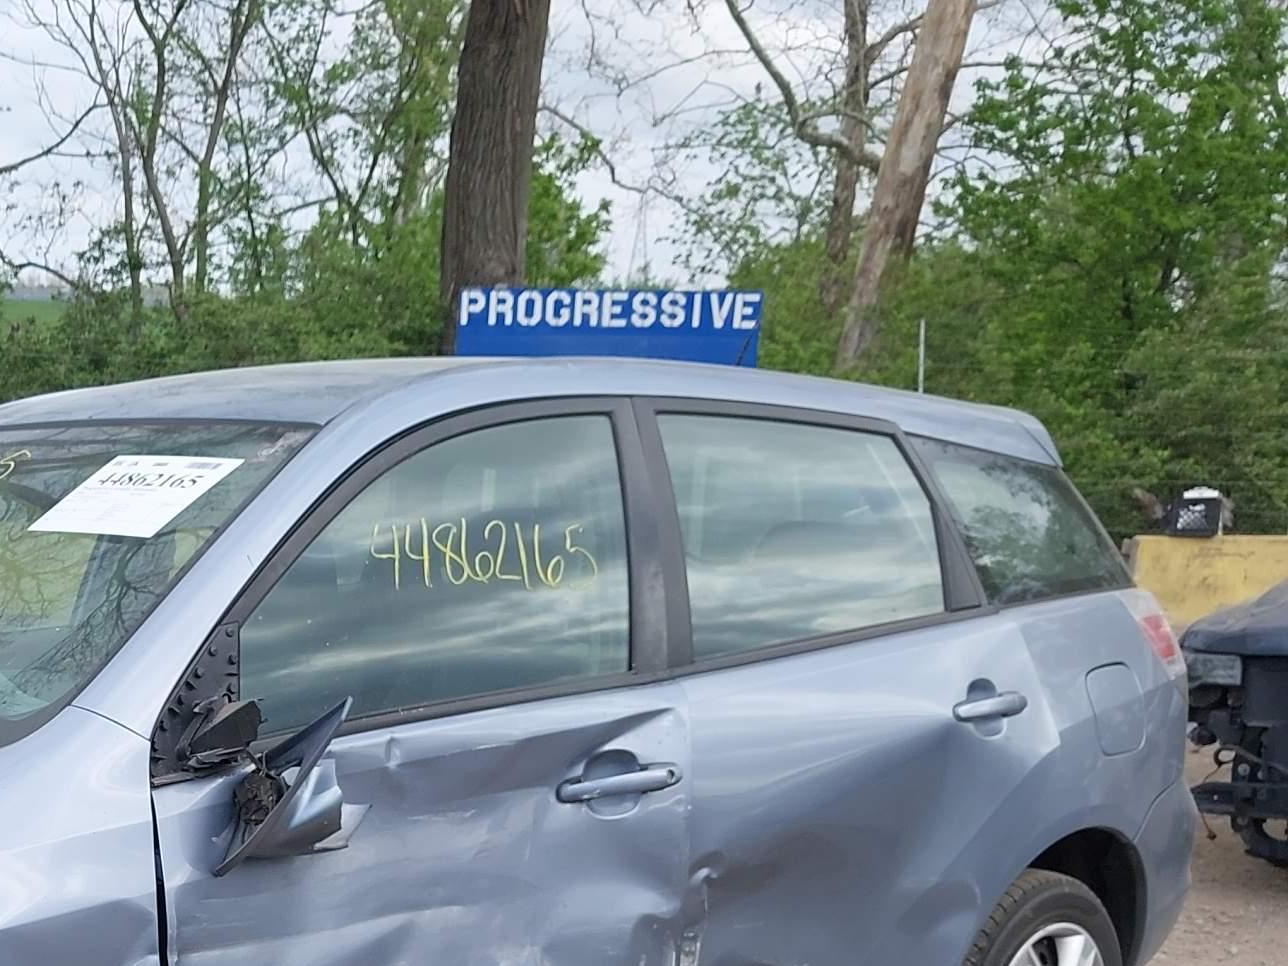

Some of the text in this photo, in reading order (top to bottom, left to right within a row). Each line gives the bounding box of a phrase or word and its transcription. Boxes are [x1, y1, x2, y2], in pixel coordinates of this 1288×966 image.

[459, 289, 761, 330] PROGRESSIVE
[97, 472, 205, 489] 44862165
[370, 517, 598, 591] 44862165
